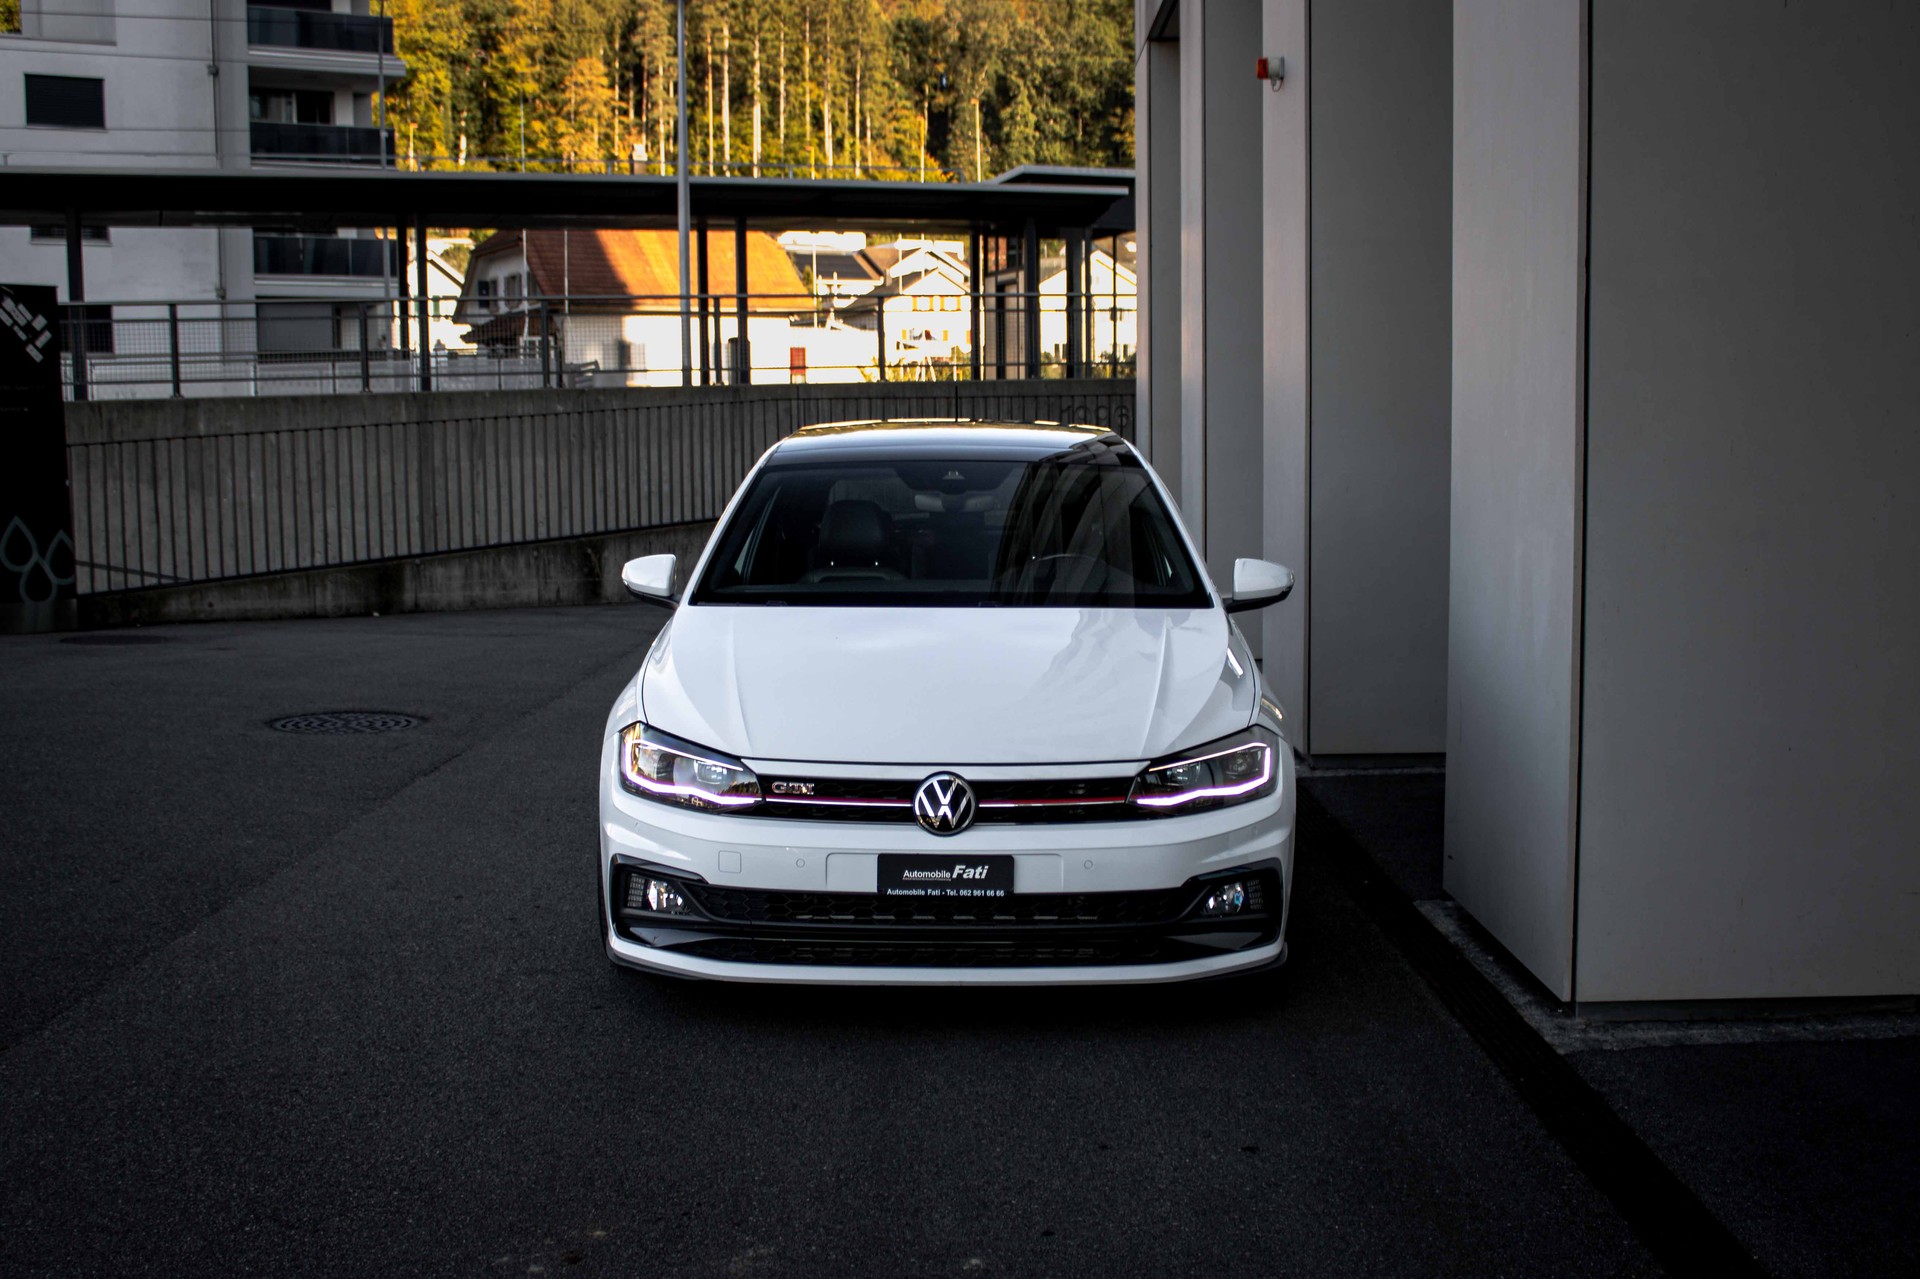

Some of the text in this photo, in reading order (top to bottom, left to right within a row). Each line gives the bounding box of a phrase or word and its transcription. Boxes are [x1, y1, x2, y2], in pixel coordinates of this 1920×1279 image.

[771, 781, 815, 795] GTI
[917, 776, 973, 830] VW
[903, 864, 989, 879] Automobile Fati
[887, 888, 925, 896] Automobile
[946, 889, 958, 897] Tel.
[960, 889, 972, 897] 062
